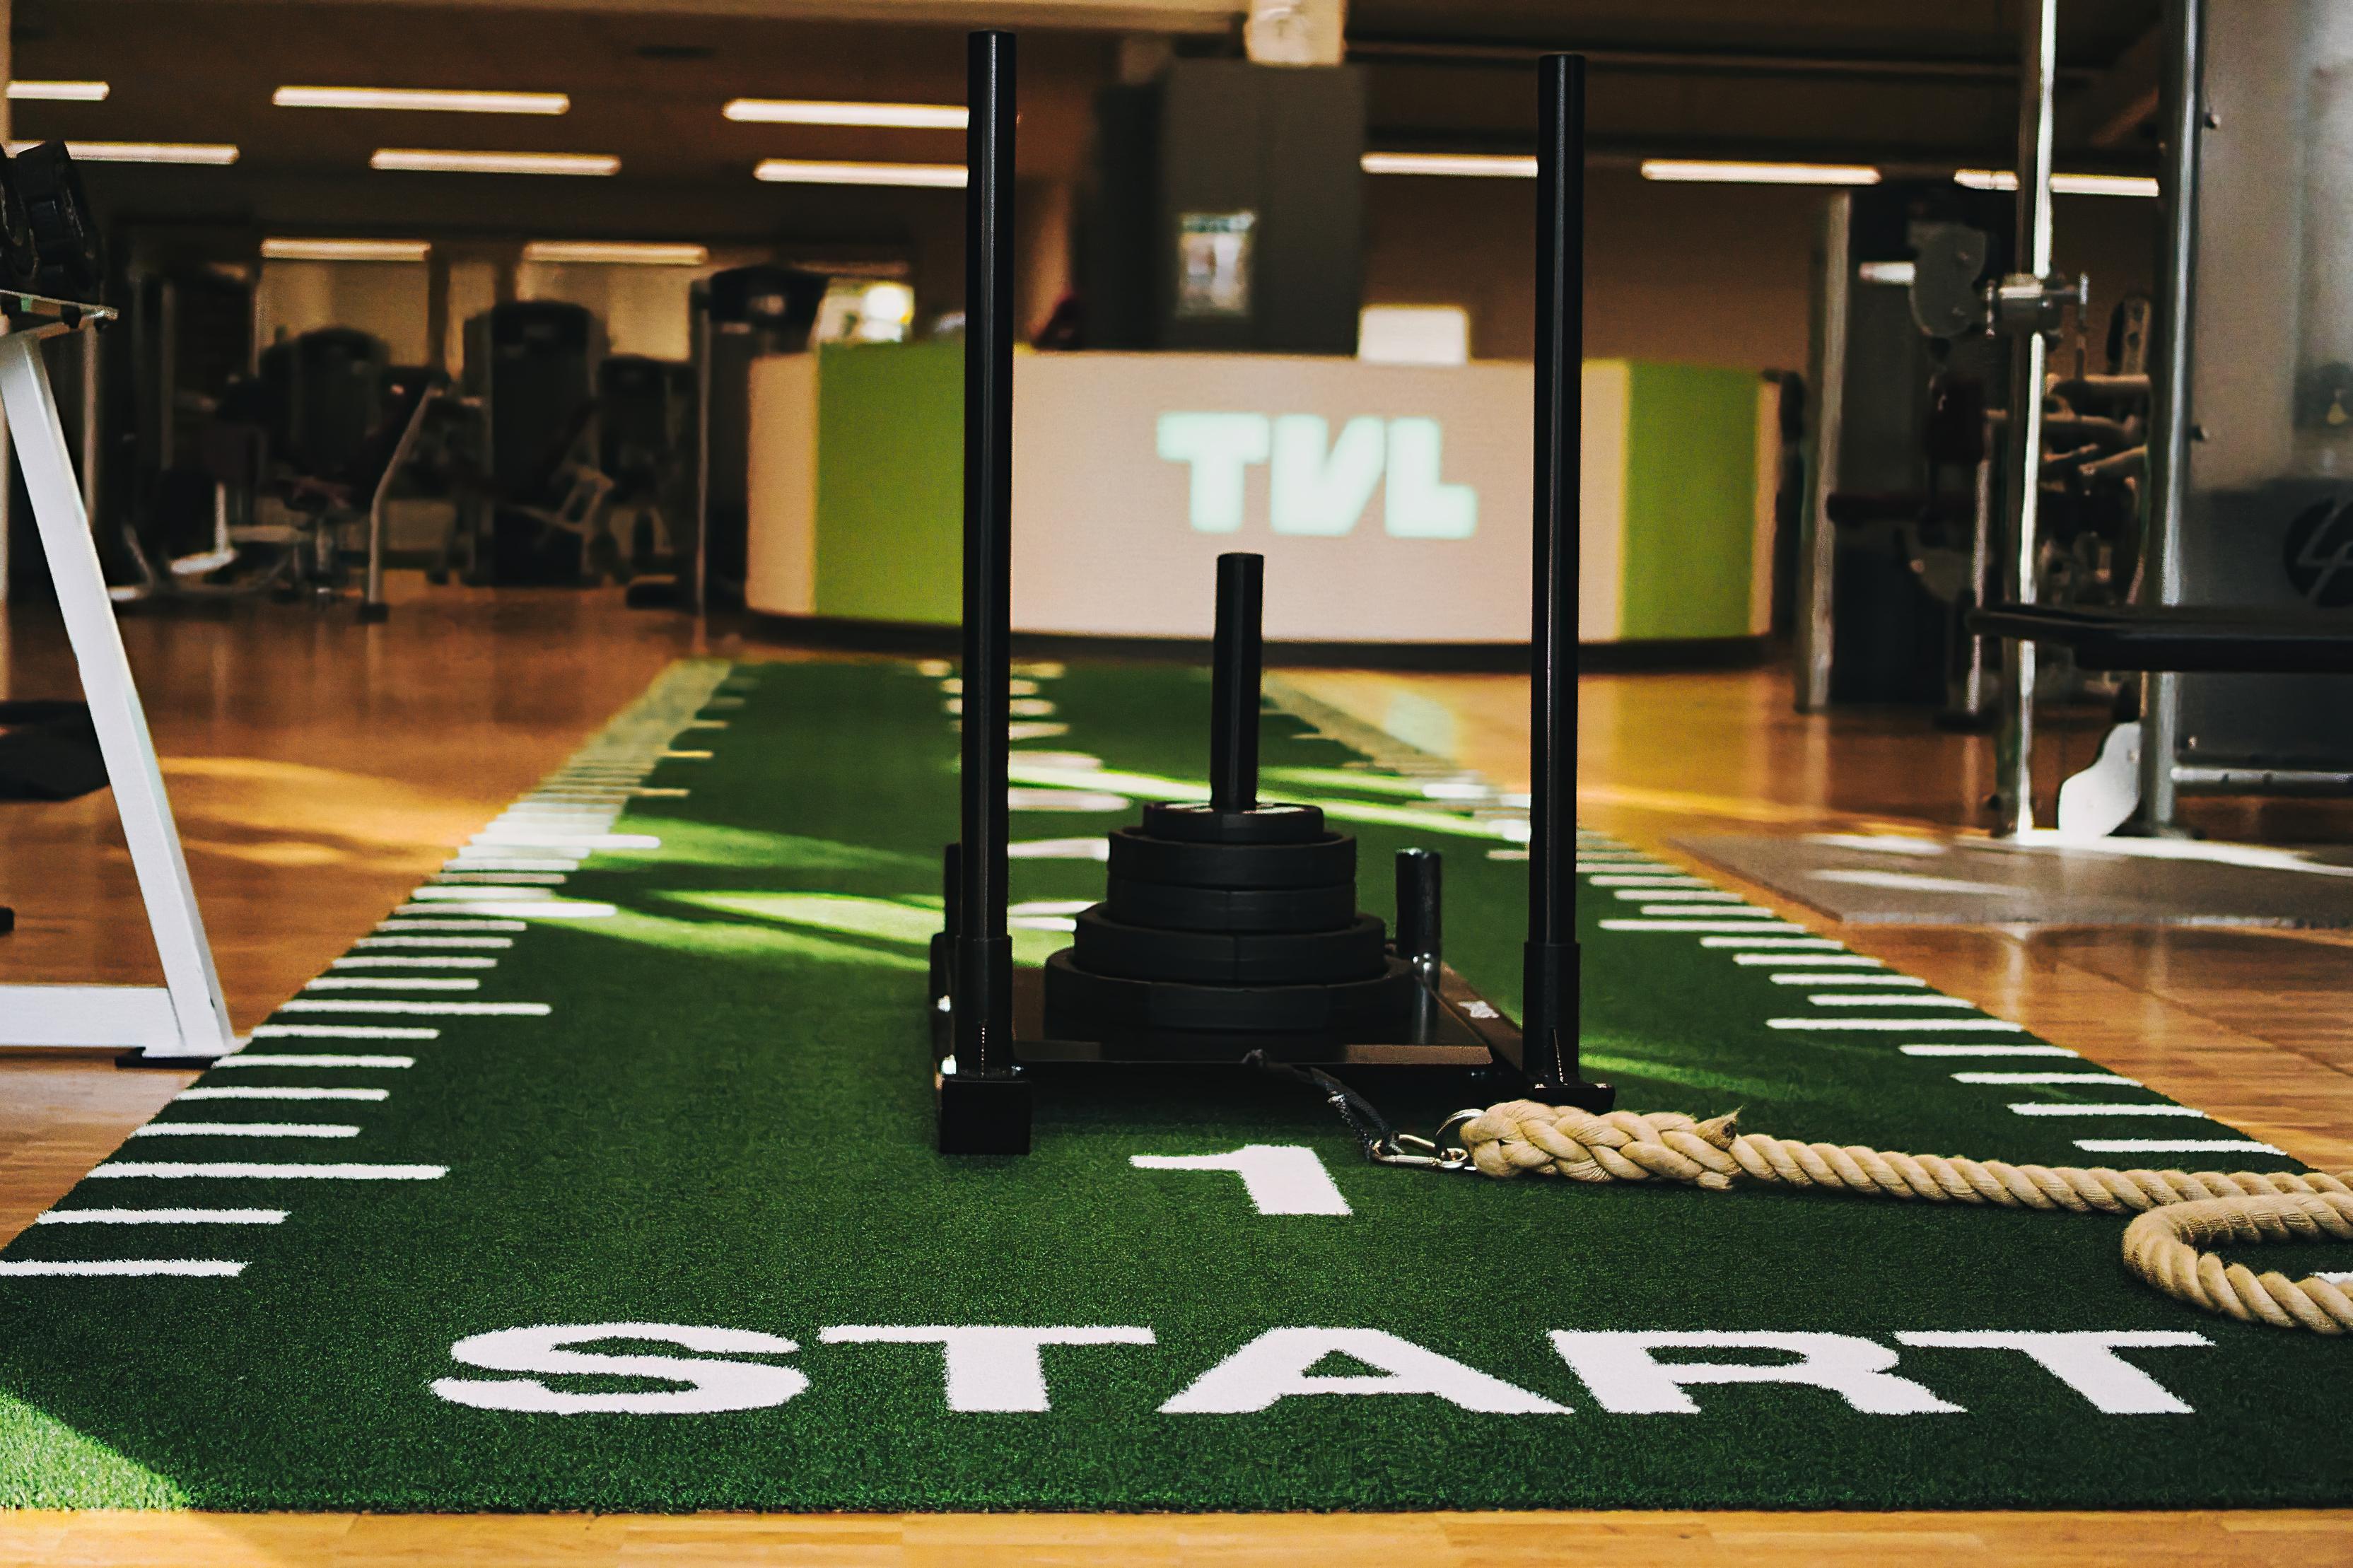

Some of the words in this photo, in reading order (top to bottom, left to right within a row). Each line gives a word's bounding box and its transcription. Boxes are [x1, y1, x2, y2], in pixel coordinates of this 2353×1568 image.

[1157, 411, 1478, 539] TVL
[1128, 1143, 1353, 1216] 1
[428, 1321, 2217, 1417] START
